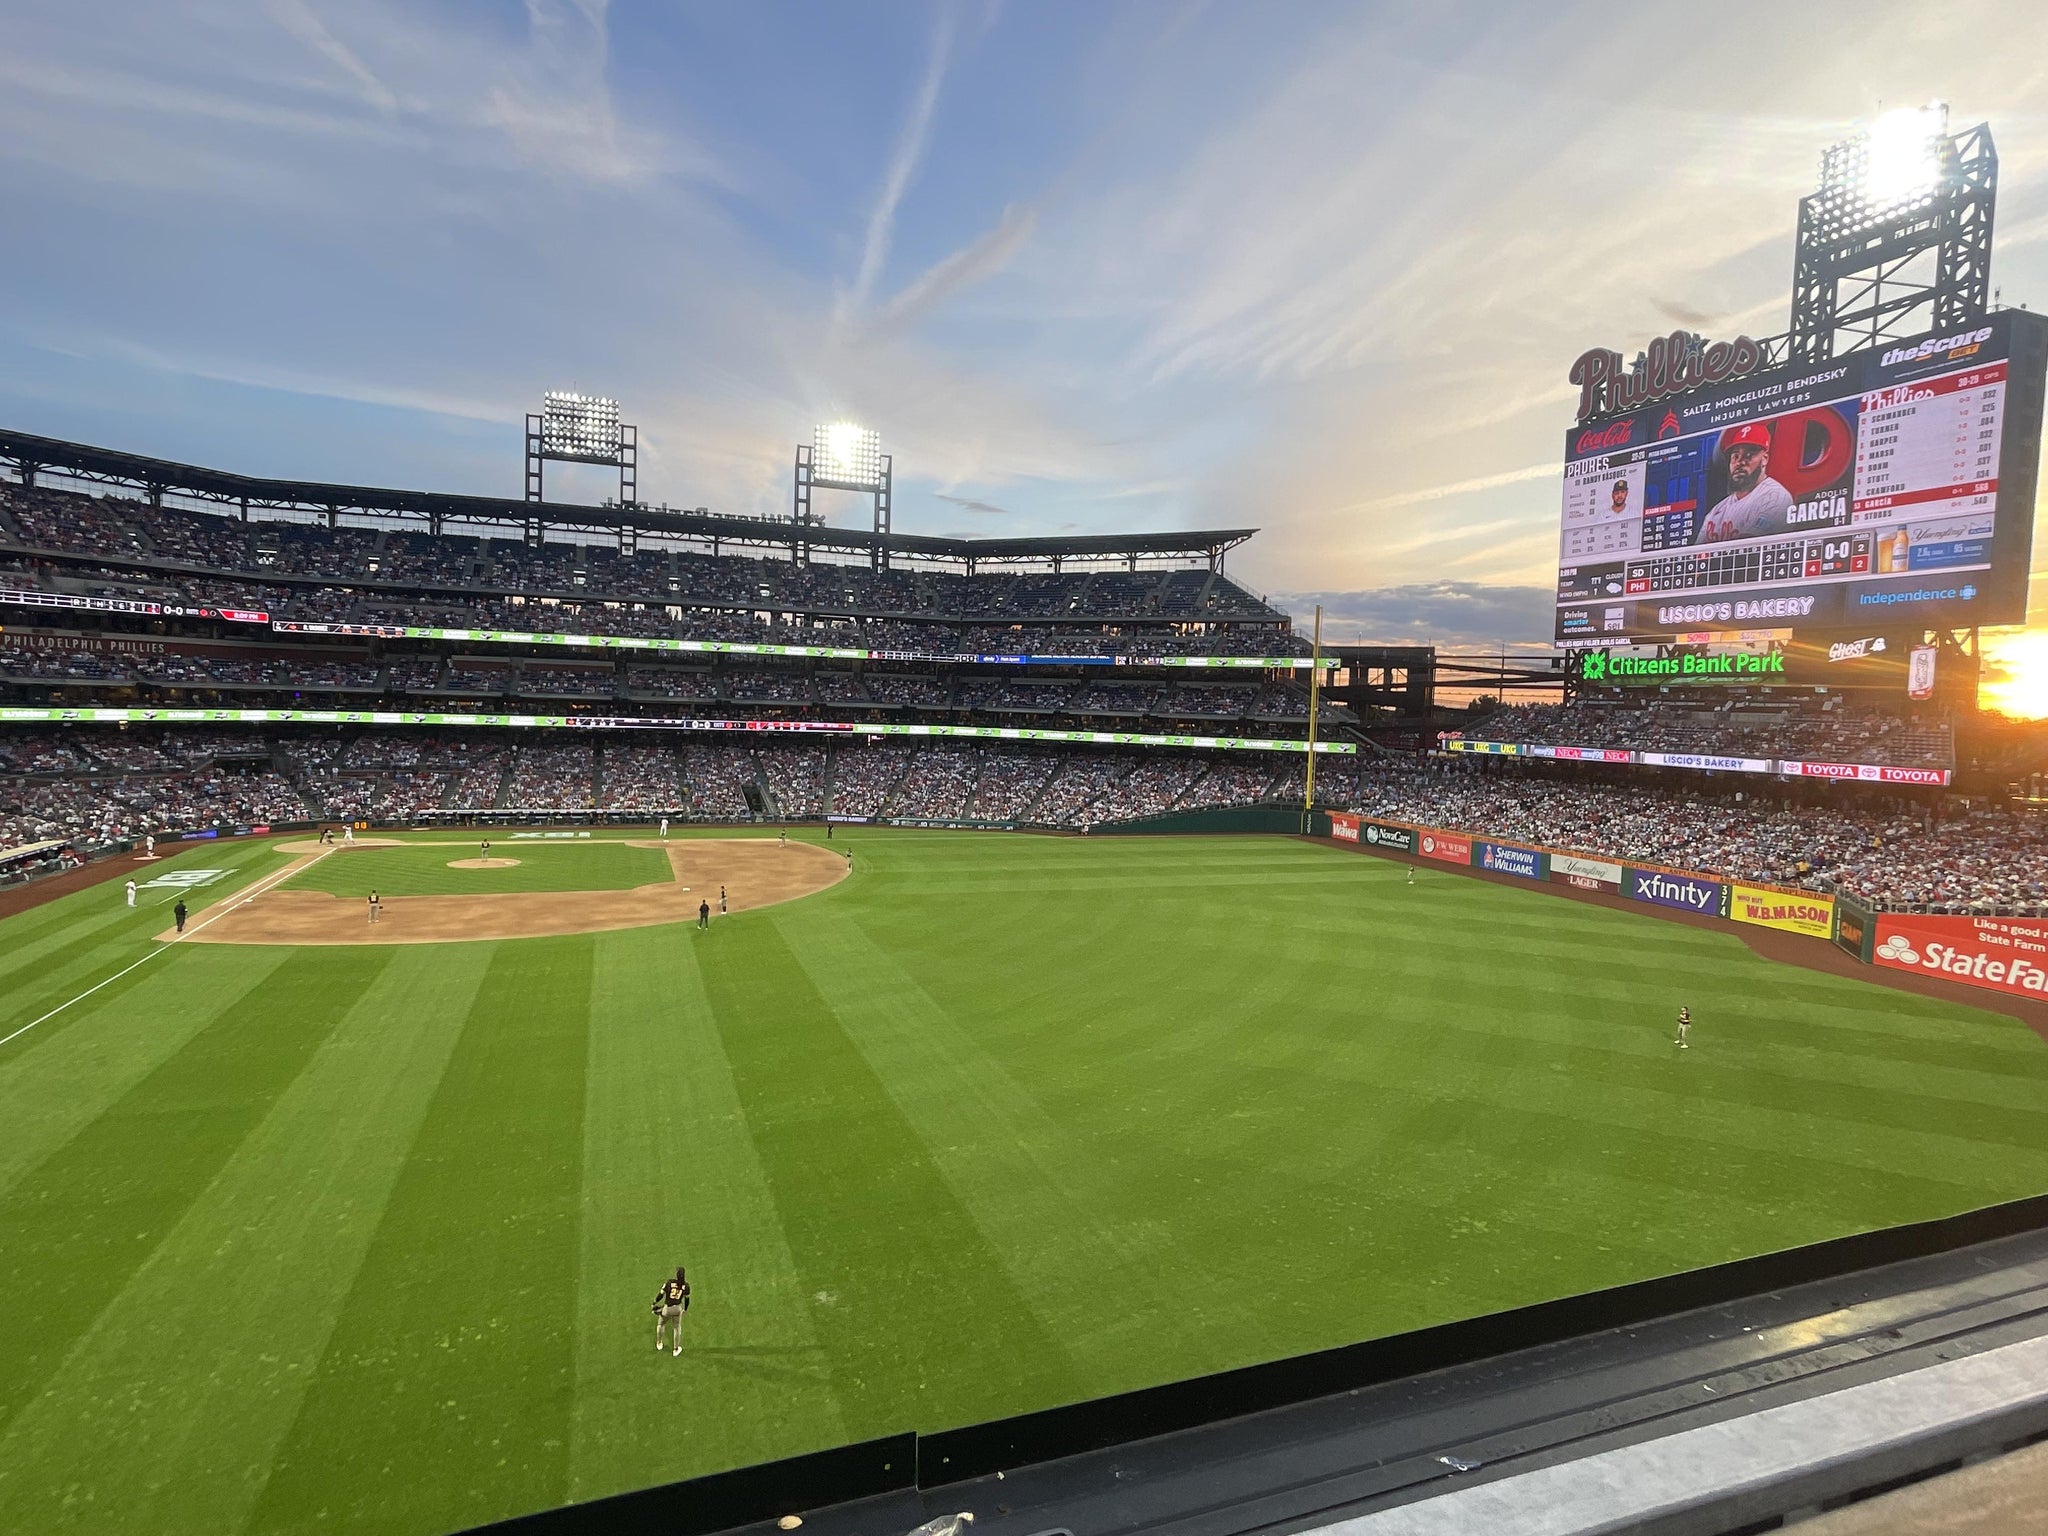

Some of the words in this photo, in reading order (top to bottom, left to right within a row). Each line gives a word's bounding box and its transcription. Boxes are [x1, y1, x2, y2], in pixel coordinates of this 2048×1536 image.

[1880, 326, 1993, 367] theScore
[1569, 330, 1760, 422] Phillies
[1683, 405, 1711, 418] SALTZ
[1715, 384, 1782, 410] MONGELUZZI
[1787, 367, 1847, 391] BENDESKY
[1861, 386, 1935, 414] Phillies
[1711, 408, 1750, 423] INJURY
[1758, 392, 1811, 412] LAWYERS
[1872, 424, 1899, 436] TURNER
[1870, 436, 1898, 448] HARPER
[1568, 457, 1610, 478] PADRES
[1867, 474, 1890, 484] STOTT
[1815, 488, 1848, 500] ADOLIS
[1866, 484, 1905, 496] CRAWFORD
[1786, 496, 1846, 524] GARCÍA
[1865, 497, 1892, 508] GARCÍA
[1834, 516, 1845, 526] 0-1
[1912, 524, 1967, 542] Yuengling
[1954, 544, 1963, 553] 95
[1632, 569, 1644, 578] SD
[1700, 562, 1706, 570] 0
[1766, 554, 1772, 562] 2
[1824, 541, 1850, 560] 0-0
[1858, 544, 1864, 552] 2
[1630, 583, 1645, 592] PHI
[1778, 568, 1785, 576] 4
[1856, 560, 1863, 568] 2
[1860, 587, 1956, 606] Independence
[164, 606, 184, 616] 0-0
[1564, 611, 1588, 619] Driving
[1658, 603, 1732, 624] LISCIO'S
[1734, 596, 1814, 619] BAKERY
[1563, 626, 1596, 634] outcomes.
[4, 635, 102, 651] PHILADELPHIA
[110, 641, 165, 653] PHILLIES
[1609, 656, 1680, 675] Citizens
[1683, 652, 1732, 673] Bank
[1736, 650, 1784, 672] Park
[1557, 748, 1580, 758] NECA
[1606, 751, 1628, 760] NECA
[1663, 755, 1702, 766] LISCIO'S
[1704, 758, 1744, 768] BAKERY
[1806, 763, 1855, 776] TOYOTA
[1884, 768, 1940, 782] TOYOTA
[1333, 823, 1358, 840] Wawa
[1379, 828, 1410, 844] NovaCare
[1448, 842, 1468, 854] WEBB
[1496, 847, 1534, 864] SHERWIN
[1564, 857, 1608, 878] Yuengling
[1569, 875, 1598, 888] LAGER
[1622, 861, 1660, 872] ASPLUNDH
[1669, 869, 1710, 880] ASPLUNDH
[1720, 877, 1764, 890] ASPLUNDH
[1776, 887, 1828, 900] ASPLUNDH
[1638, 874, 1712, 908] xfinity
[1720, 886, 1728, 916] 374
[1974, 918, 1998, 930] Like
[2000, 924, 2008, 932] a
[2010, 926, 2040, 938] good
[1979, 932, 2010, 946] State
[2014, 938, 2046, 952] Farm
